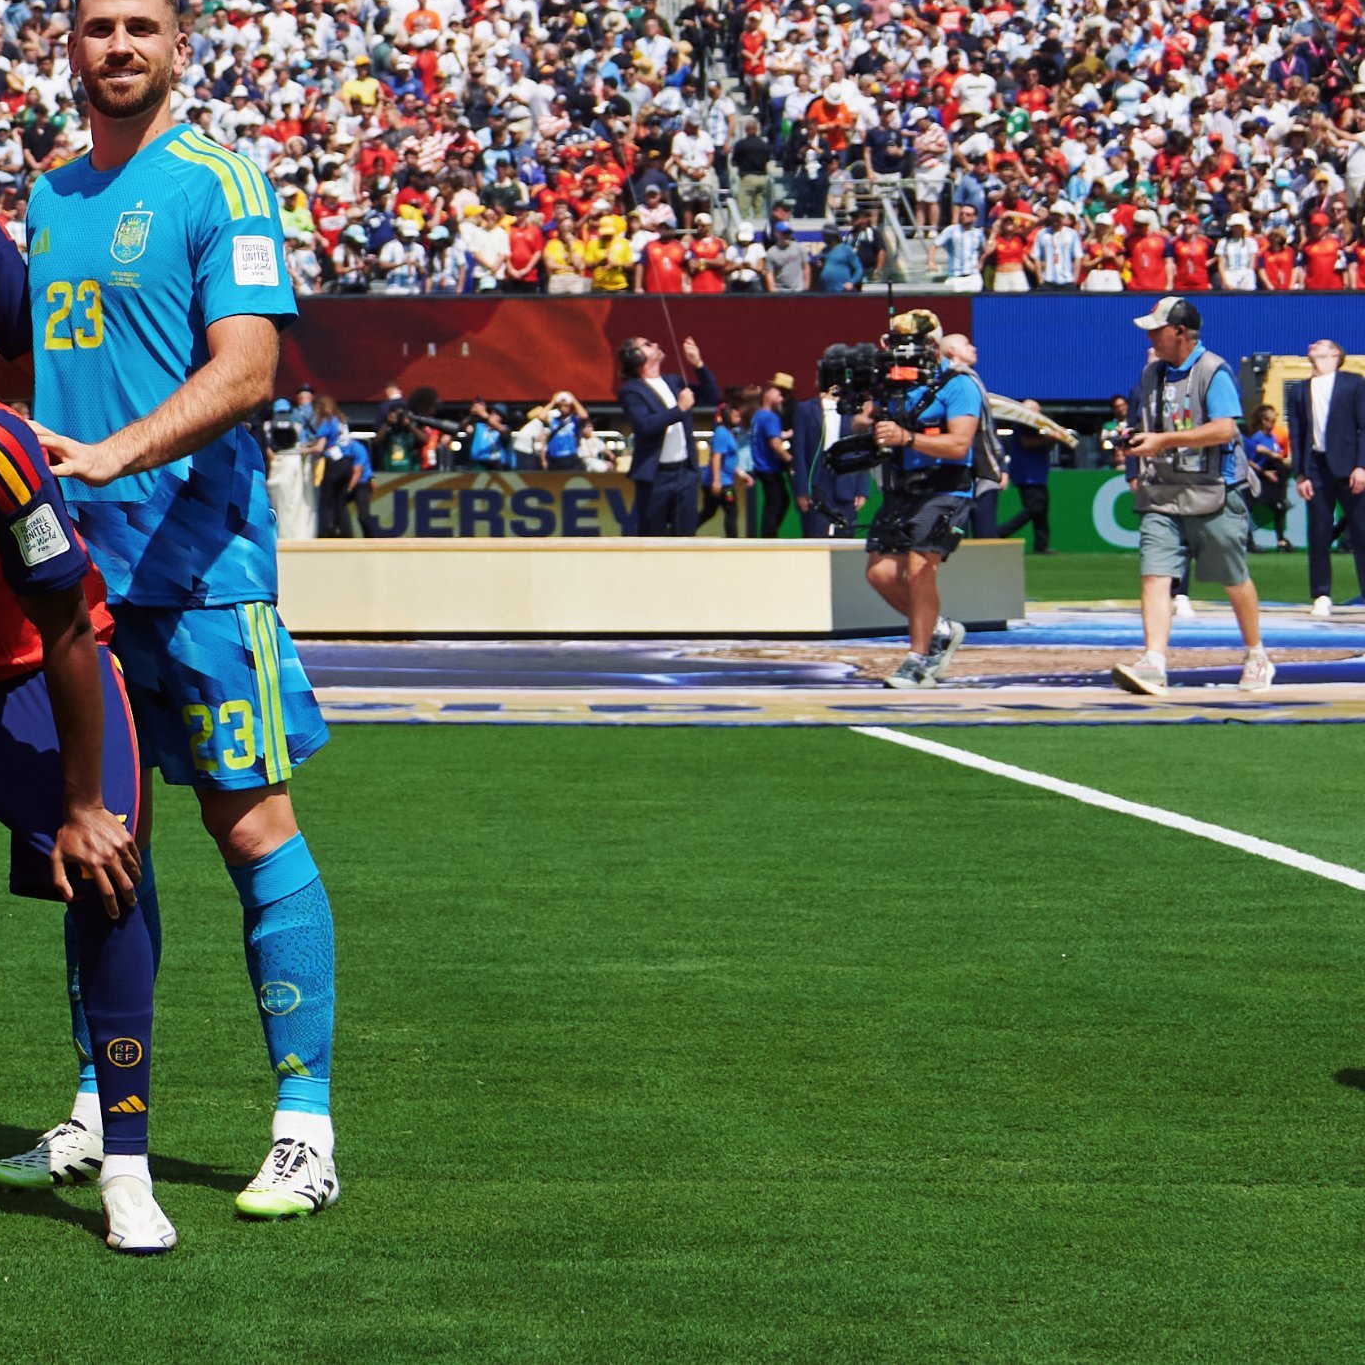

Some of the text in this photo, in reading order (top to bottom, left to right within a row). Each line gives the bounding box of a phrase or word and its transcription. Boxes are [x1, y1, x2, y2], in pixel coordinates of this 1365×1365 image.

[242, 252, 270, 262] UNITES
[44, 280, 105, 350] 23
[369, 488, 638, 538] JERSEY
[24, 522, 52, 543] UNITES
[182, 699, 257, 773] 23
[115, 1044, 134, 1052] RF
[115, 1052, 134, 1061] EF
